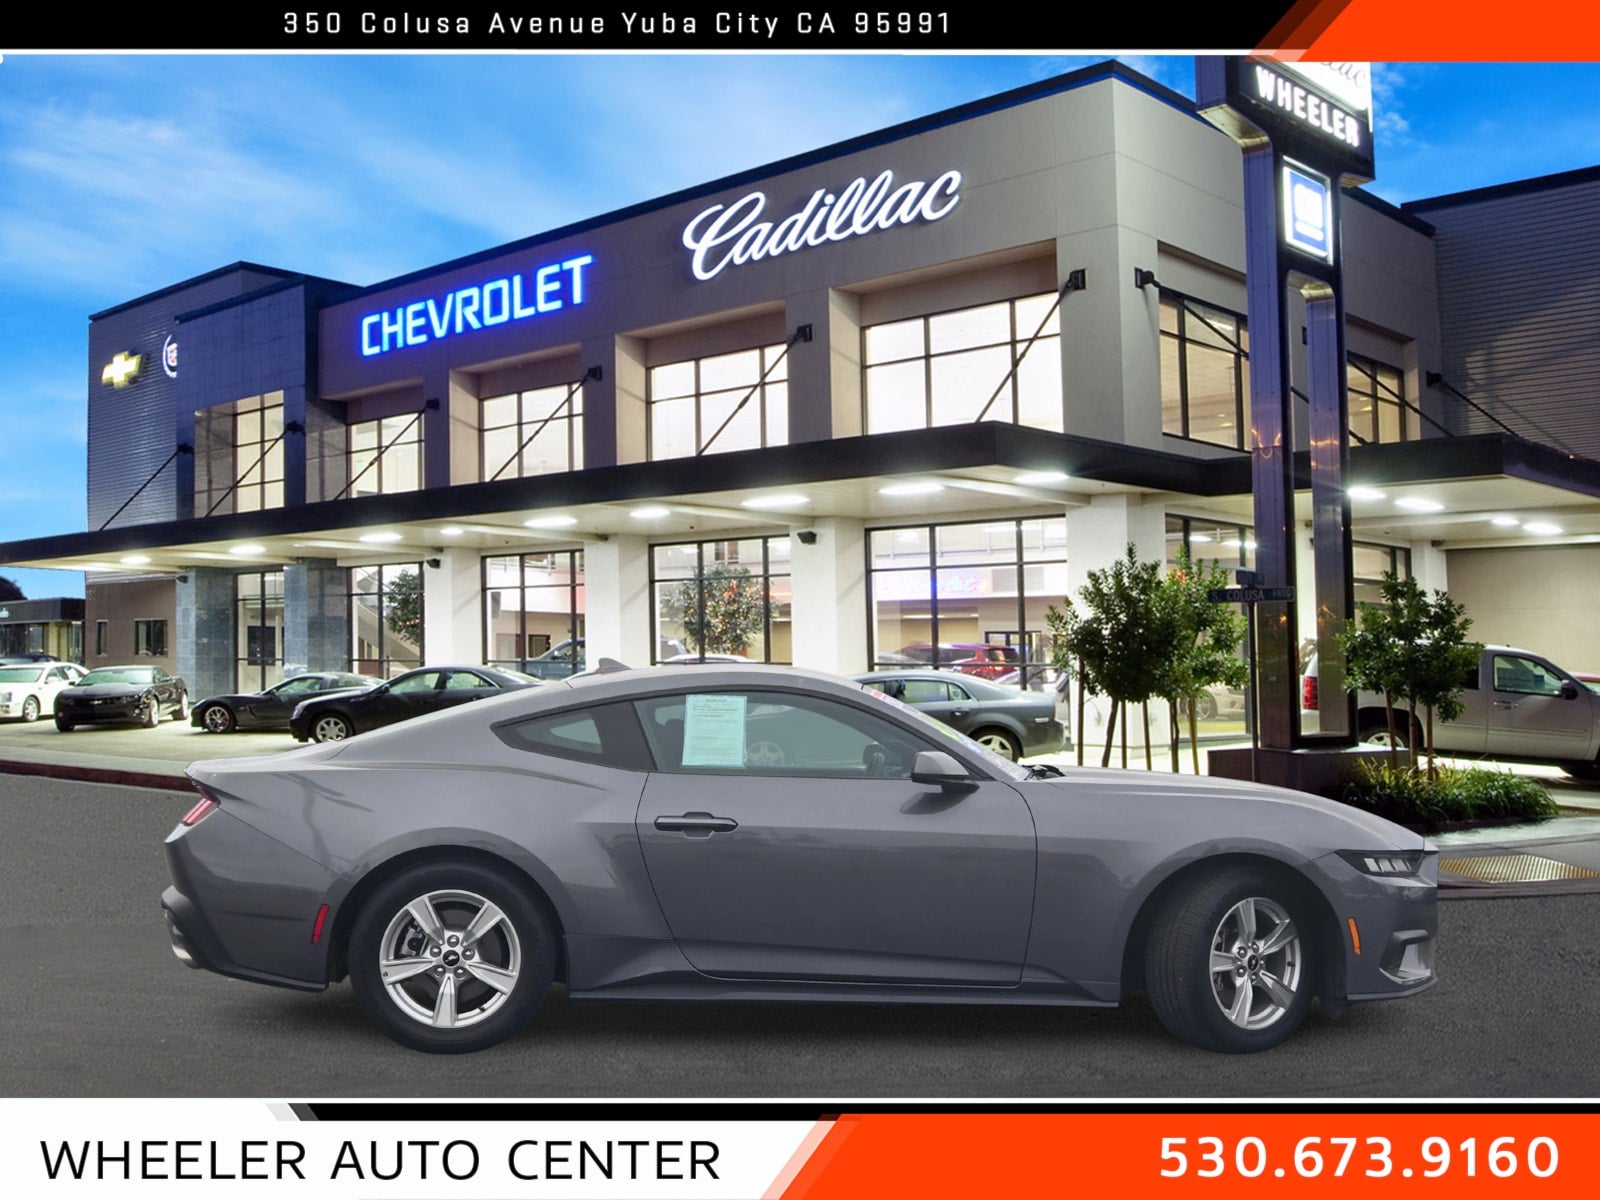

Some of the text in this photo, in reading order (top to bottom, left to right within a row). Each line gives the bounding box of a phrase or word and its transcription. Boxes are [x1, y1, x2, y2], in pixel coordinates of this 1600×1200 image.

[1256, 66, 1359, 147] WHEELER
[683, 170, 962, 281] Cadillac
[362, 255, 593, 356] CHEVROLET
[1226, 589, 1265, 602] COLUSA
